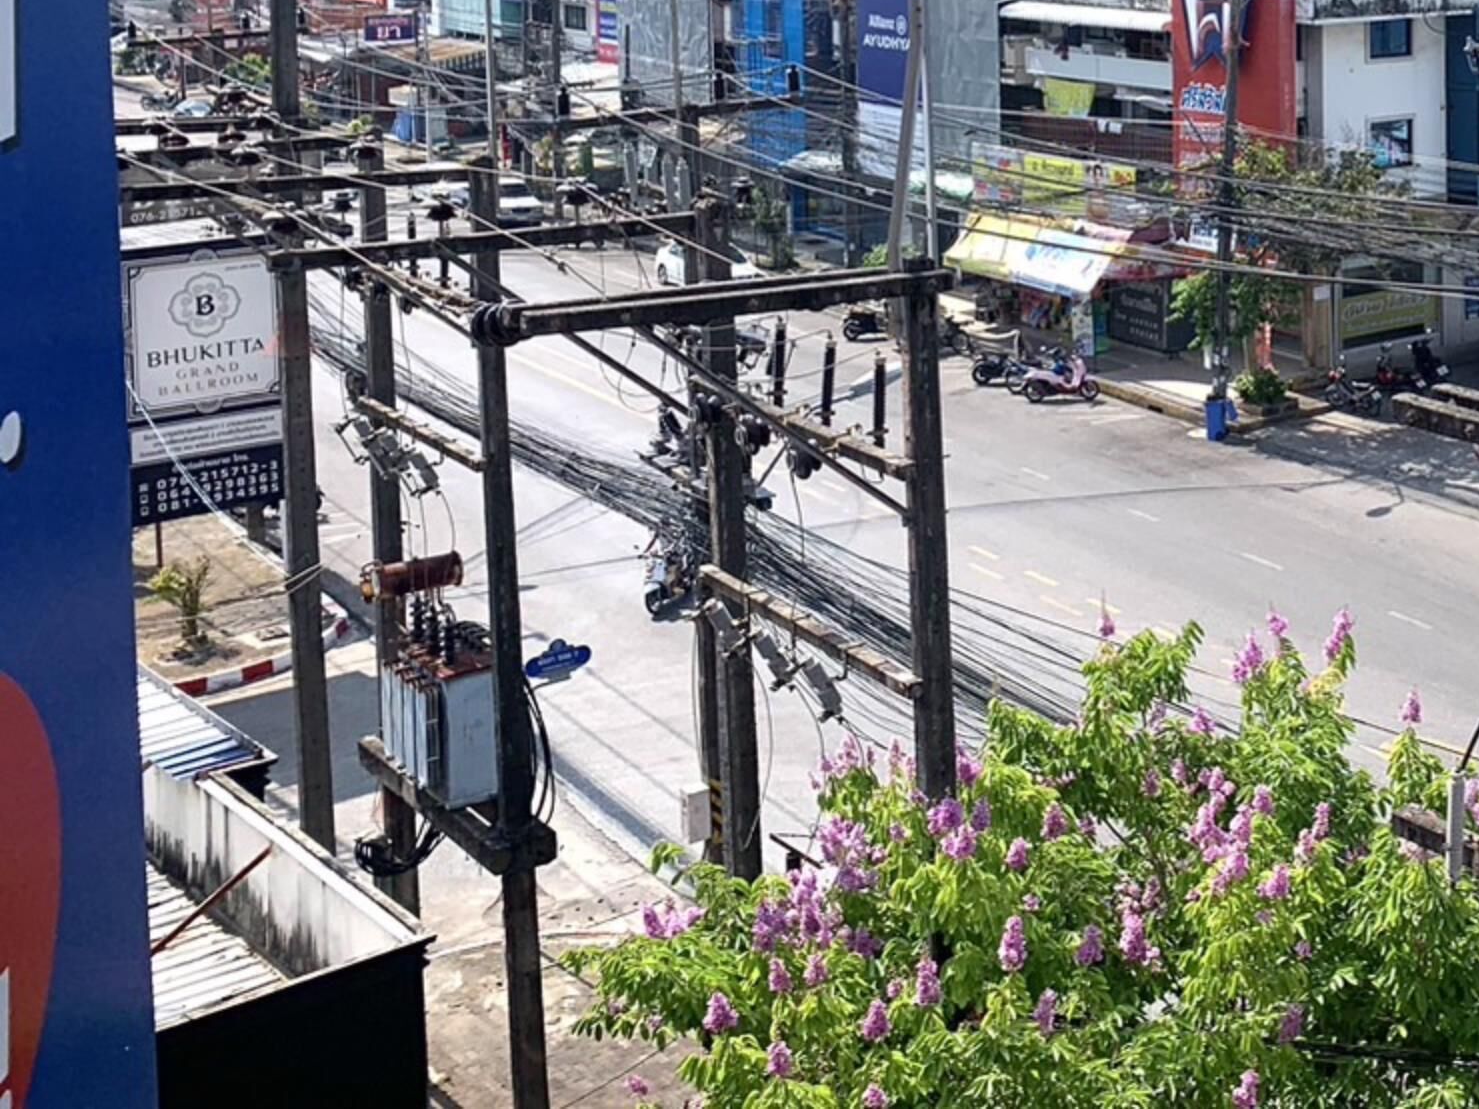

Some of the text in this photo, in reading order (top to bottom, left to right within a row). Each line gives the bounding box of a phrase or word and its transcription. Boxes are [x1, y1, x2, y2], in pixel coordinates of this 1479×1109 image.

[195, 294, 216, 317] B
[146, 337, 265, 369] BHUKITTA
[175, 362, 240, 380] GRAND
[157, 372, 259, 397] BALLROOM
